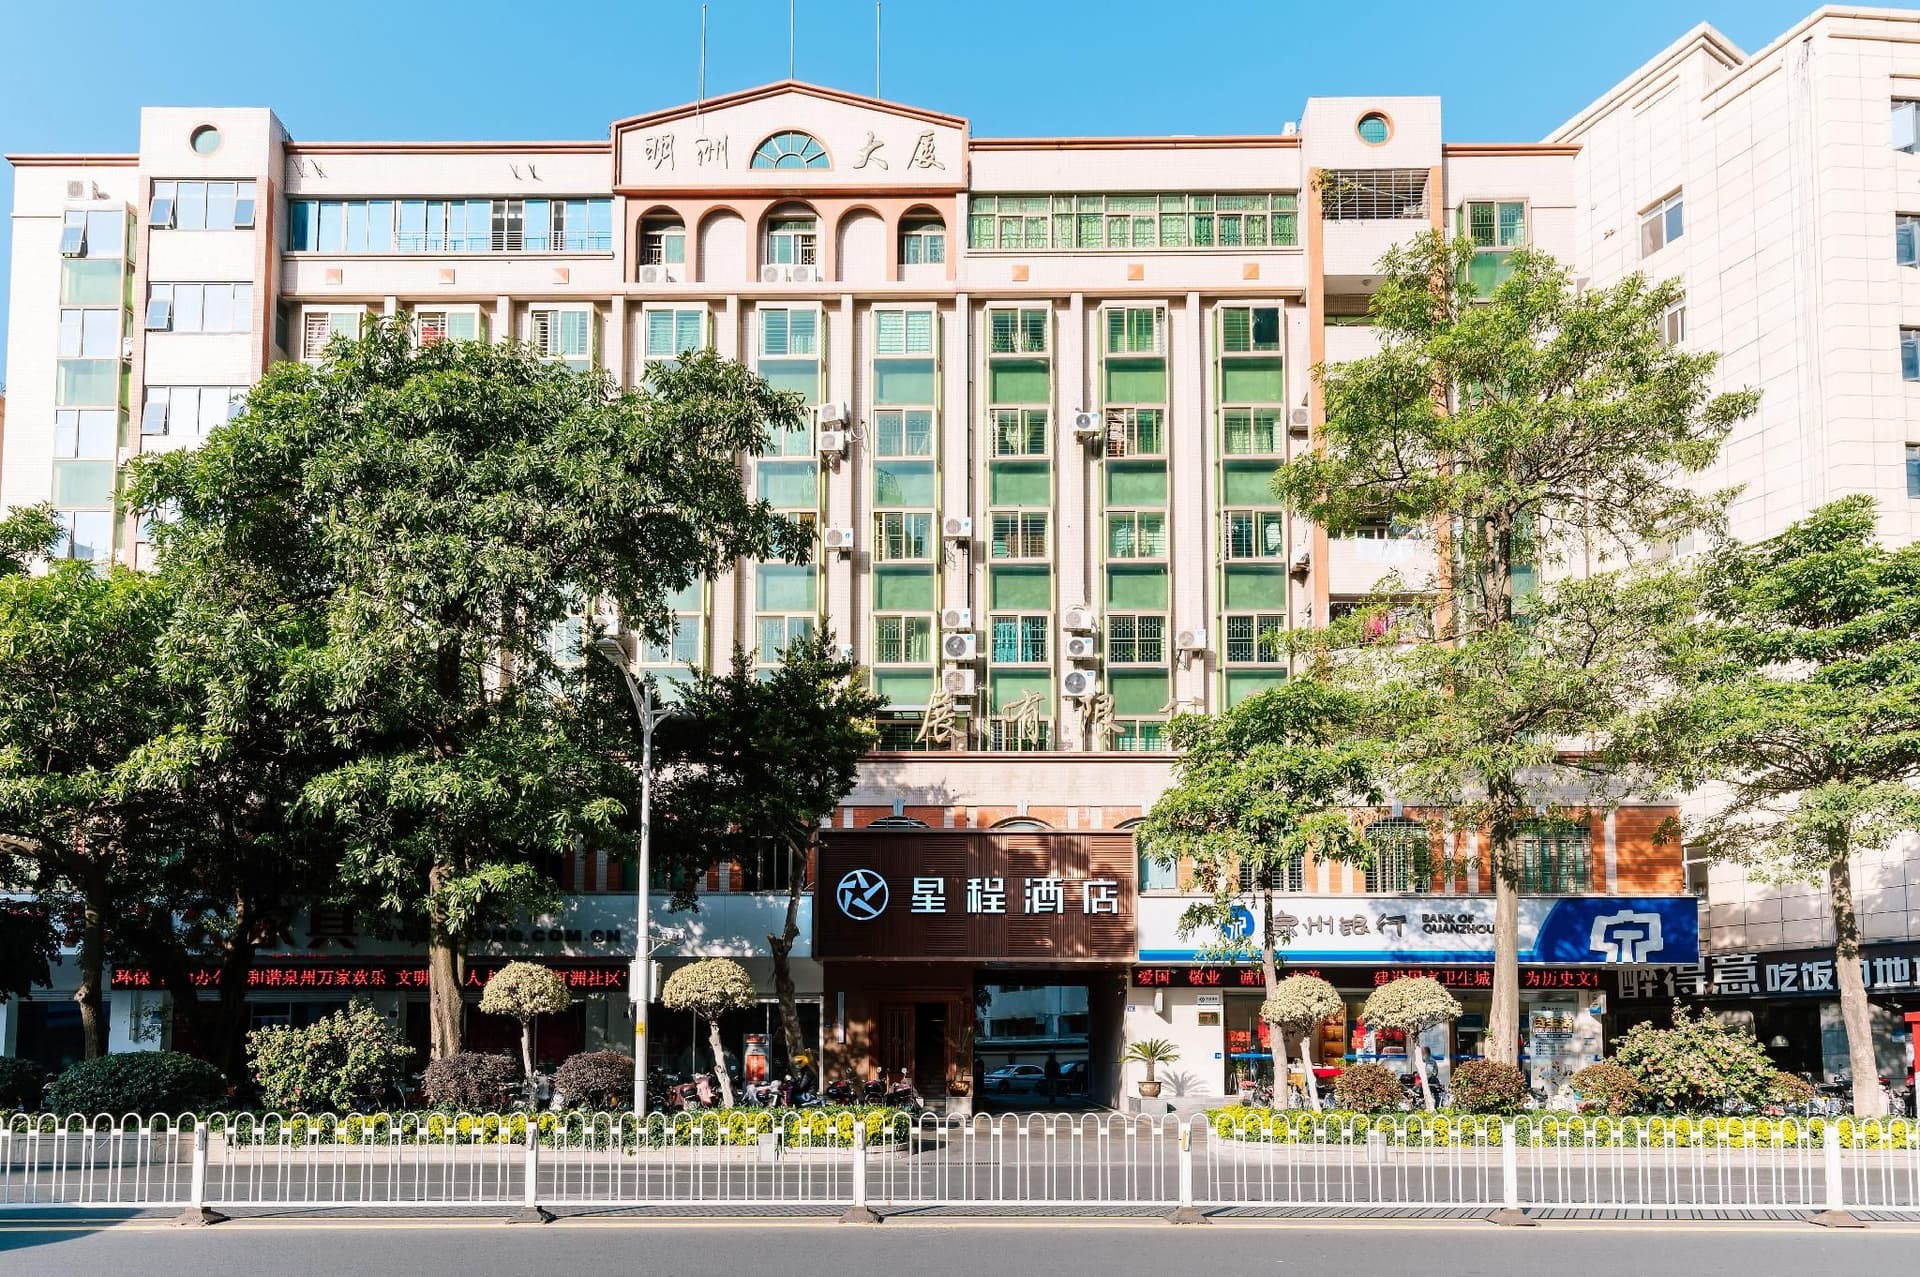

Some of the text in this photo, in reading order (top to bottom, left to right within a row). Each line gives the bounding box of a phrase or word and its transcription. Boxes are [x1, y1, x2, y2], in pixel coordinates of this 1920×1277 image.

[910, 876, 1119, 915] 星程酒店
[1273, 909, 1408, 939] 泉州银行
[1421, 913, 1475, 924] BANK OF
[1421, 923, 1495, 935] QUANZHOU
[247, 968, 387, 987] 和谐泉州万家欢乐
[1137, 969, 1171, 985] 爱国
[1188, 969, 1222, 985] 敬业
[1618, 953, 1760, 999] 醉得意
